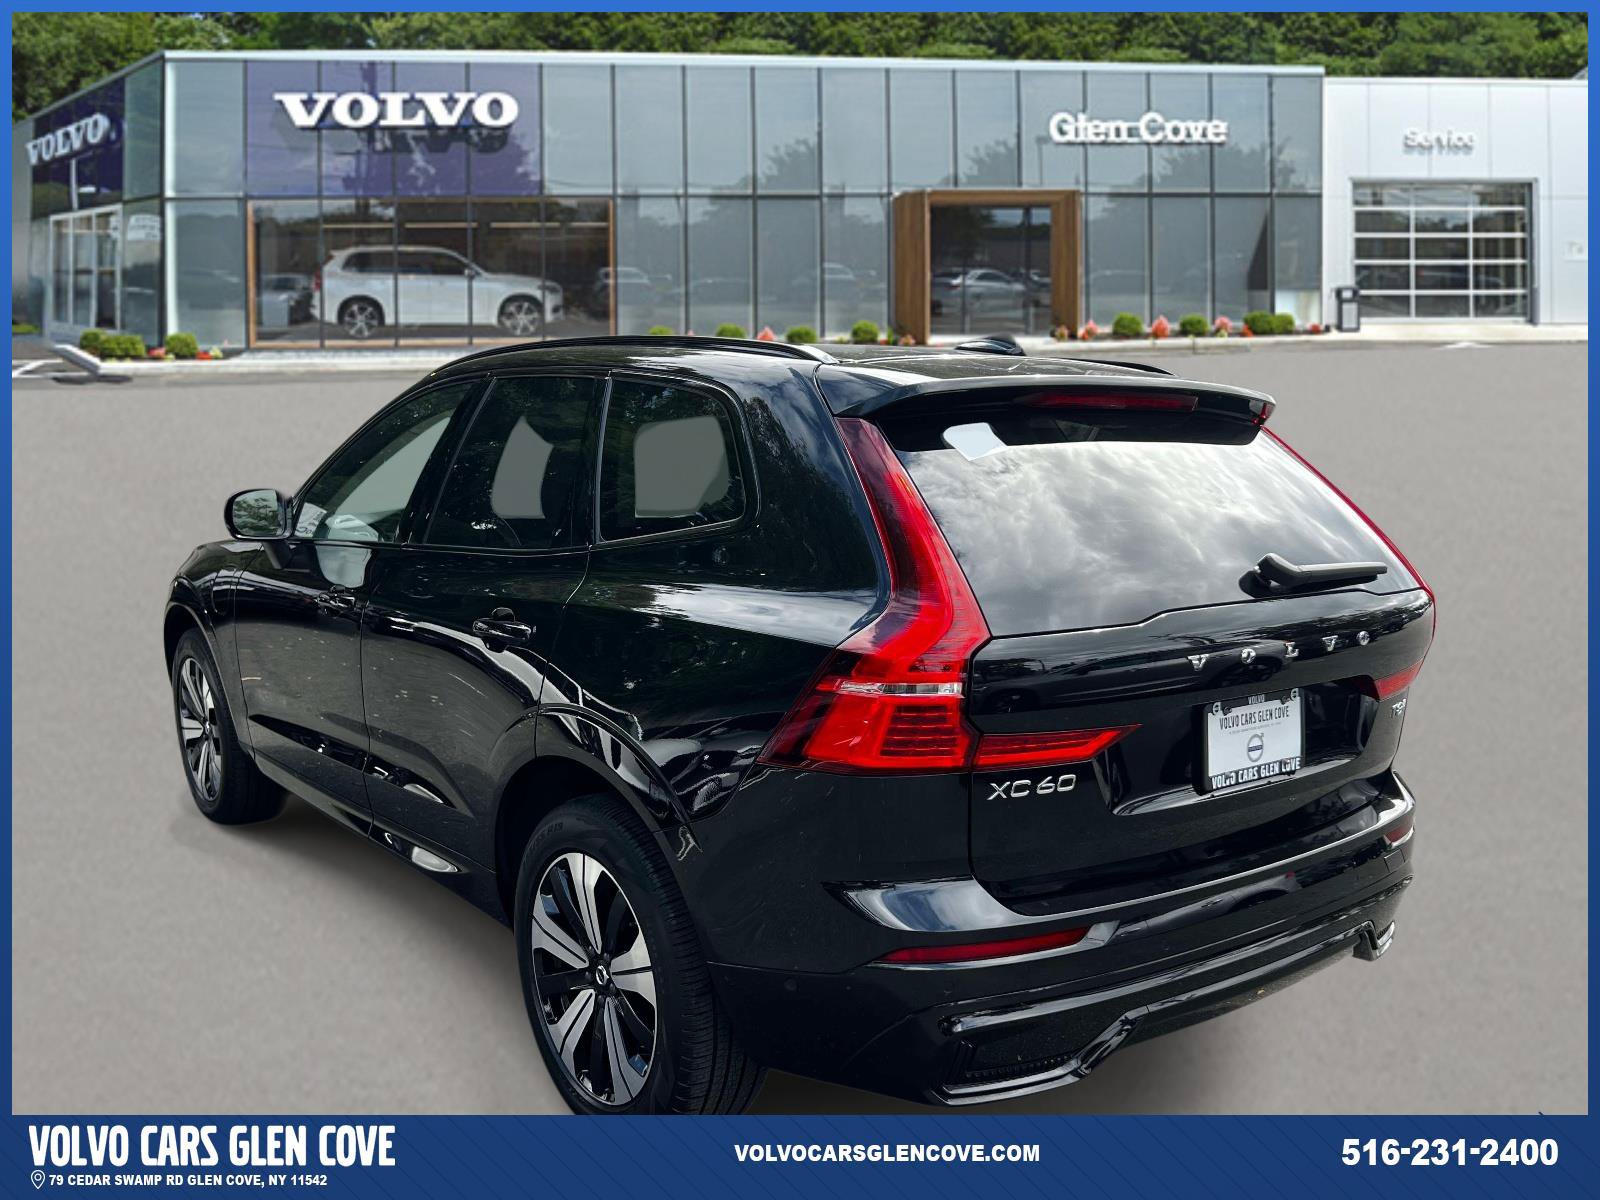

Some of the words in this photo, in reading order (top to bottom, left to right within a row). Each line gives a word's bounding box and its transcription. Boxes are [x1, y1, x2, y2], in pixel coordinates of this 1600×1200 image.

[274, 92, 519, 128] VOLVO
[25, 112, 110, 166] VOLVO
[1049, 111, 1130, 144] Glen
[1139, 111, 1228, 144] Cove
[1402, 127, 1476, 154] Service
[1187, 631, 1370, 671] VOLVO
[1247, 694, 1265, 705] VOLVO
[1219, 714, 1239, 730] VOLVO
[1240, 711, 1257, 726] CARS
[1257, 707, 1273, 722] GLEN
[1274, 705, 1290, 720] COVE
[1238, 766, 1259, 783] CARS
[1260, 762, 1280, 777] GLEN
